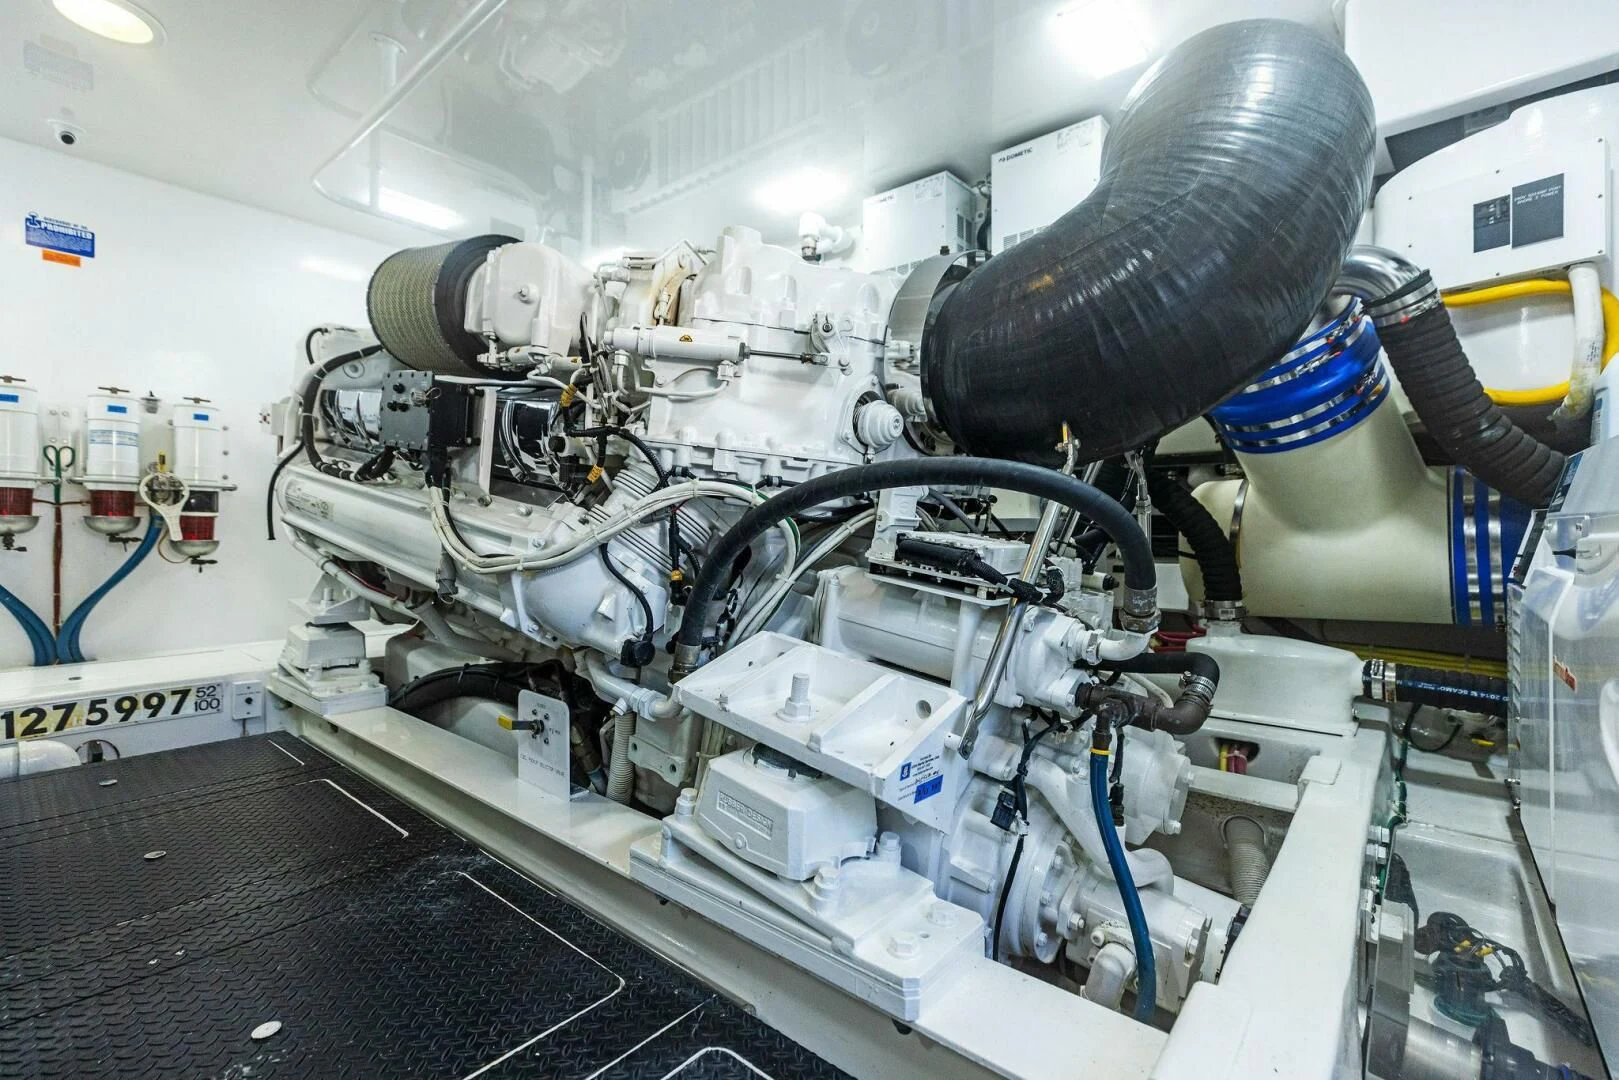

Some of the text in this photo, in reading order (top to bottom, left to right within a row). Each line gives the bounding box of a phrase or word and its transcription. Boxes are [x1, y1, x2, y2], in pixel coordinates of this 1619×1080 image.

[1006, 147, 1033, 162] DOMETIC
[41, 222, 93, 240] PROHIBITED
[196, 686, 216, 698] 52
[1480, 691, 1500, 701] 2014
[194, 698, 220, 711] 100
[1, 688, 192, 739] 1275997
